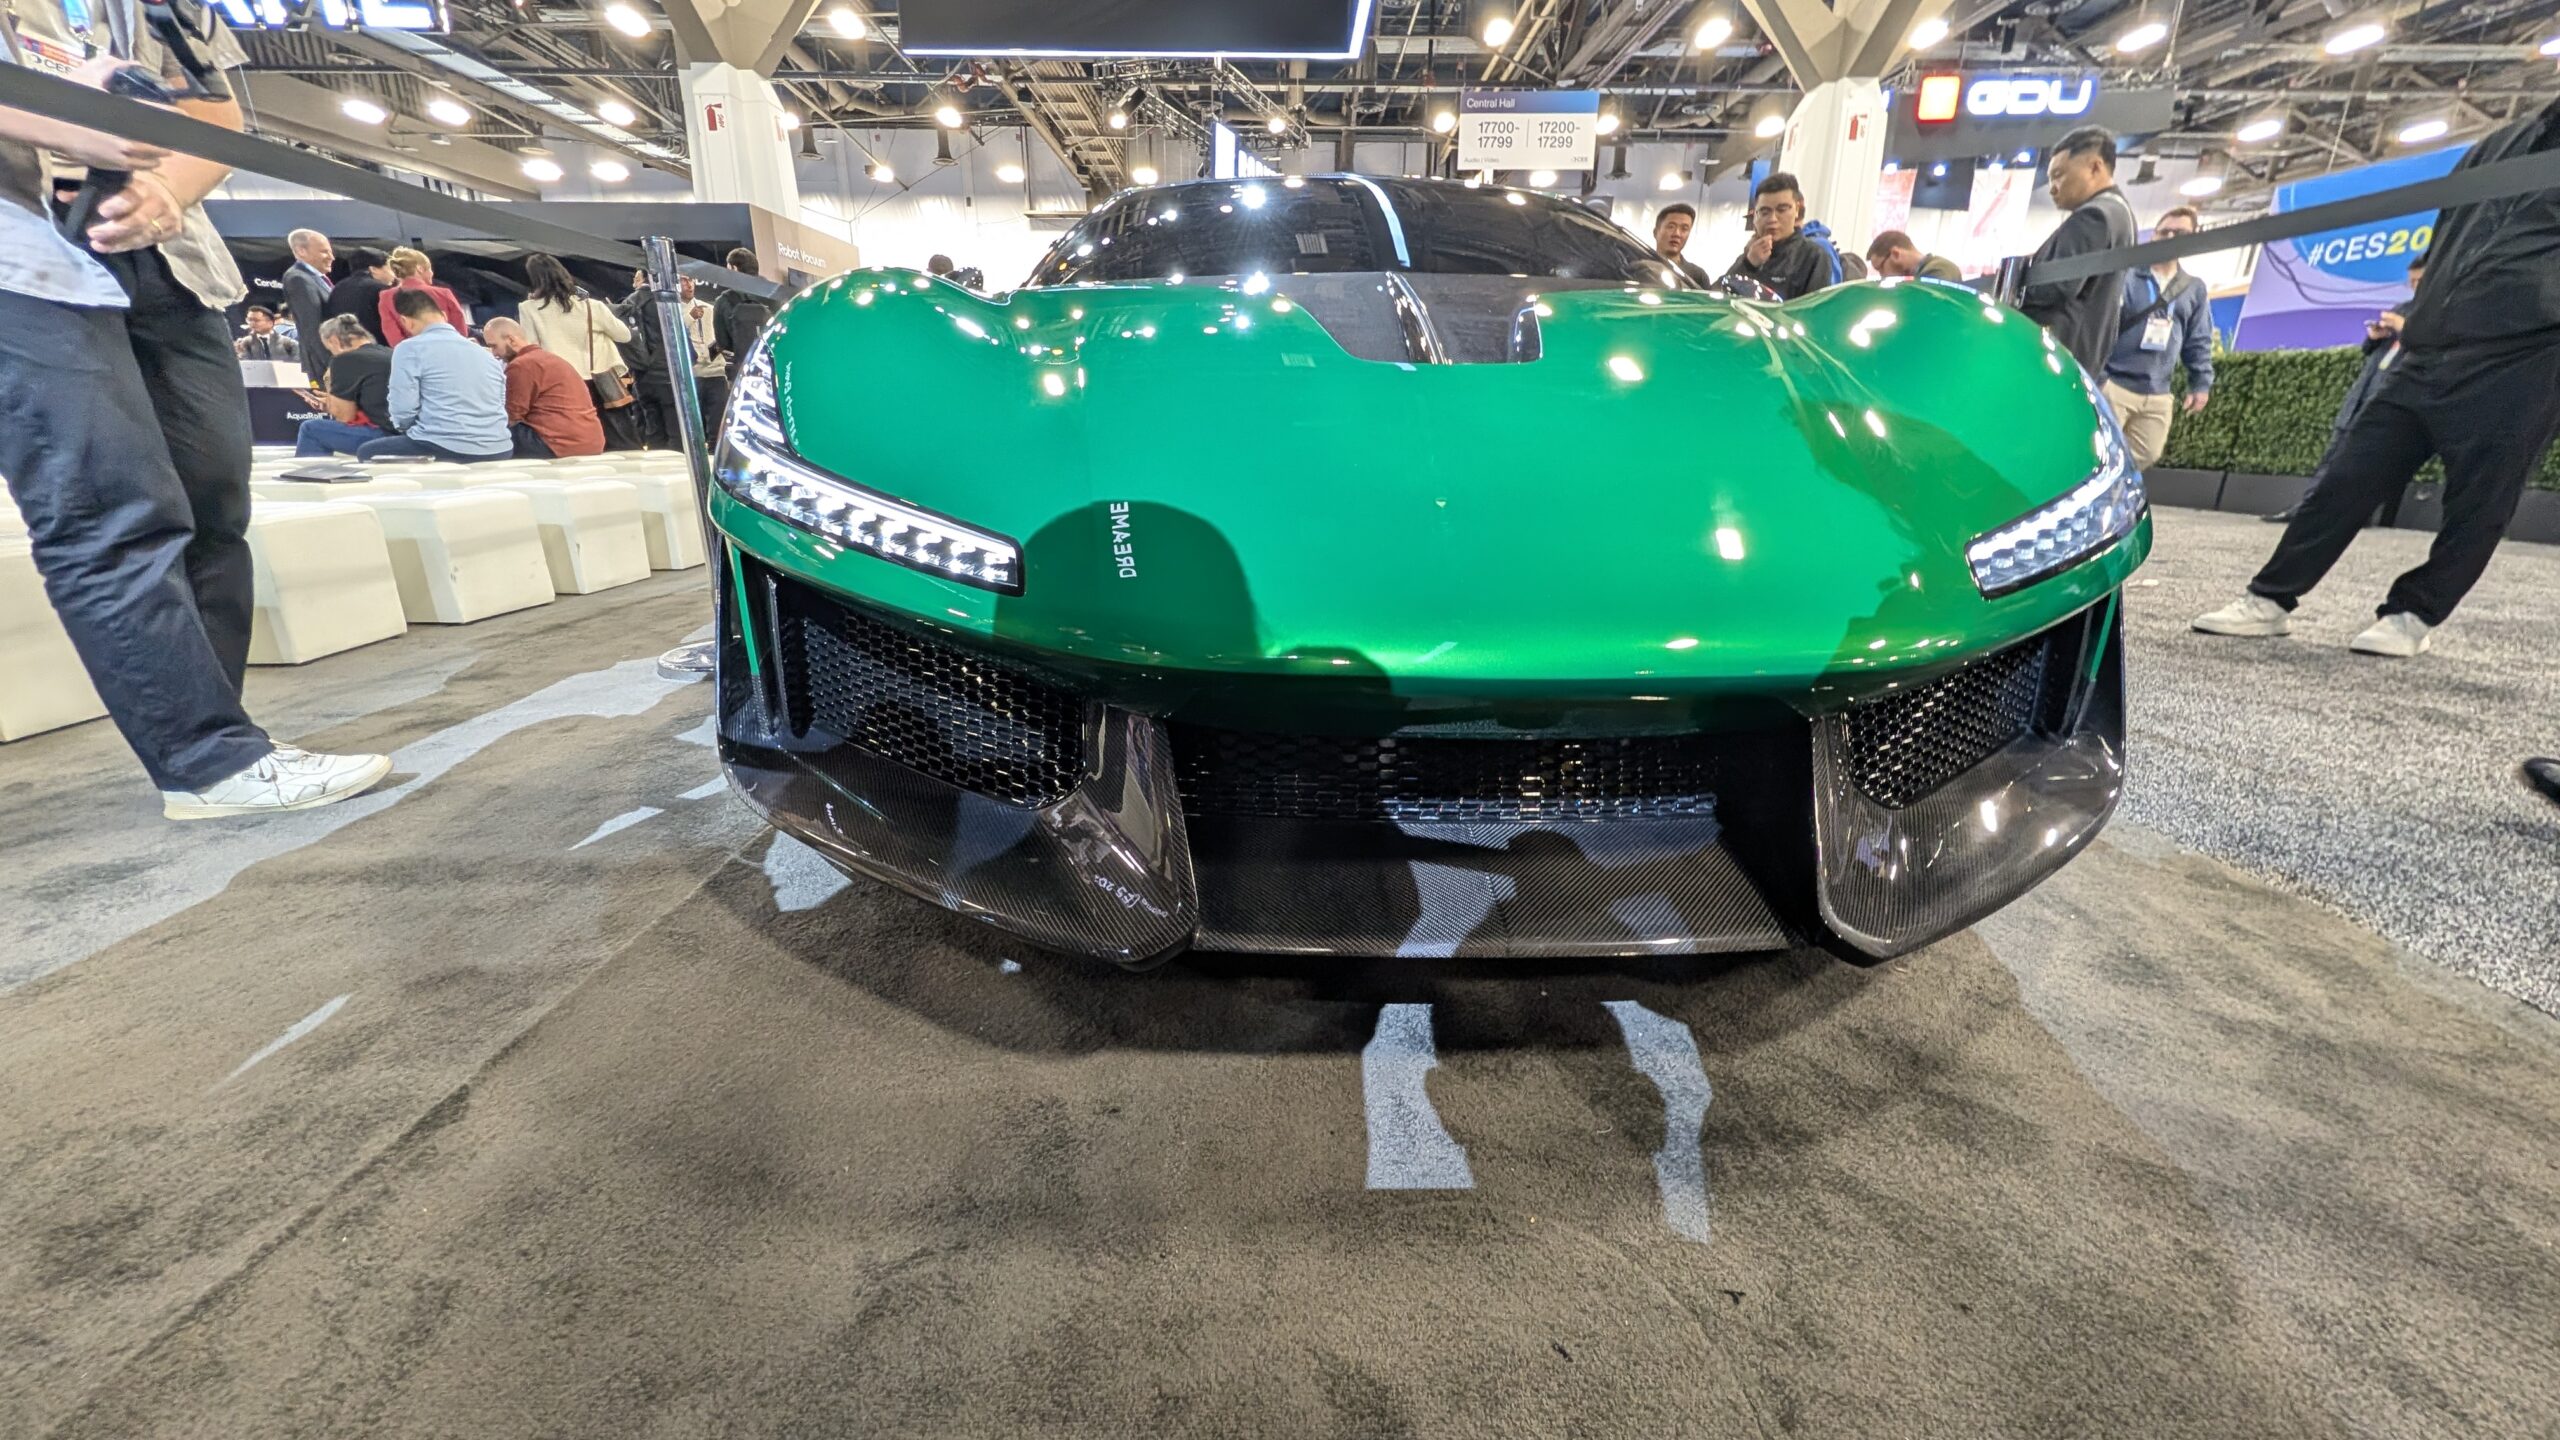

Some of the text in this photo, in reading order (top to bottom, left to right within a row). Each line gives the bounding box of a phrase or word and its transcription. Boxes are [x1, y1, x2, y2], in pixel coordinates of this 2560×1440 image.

[1466, 98, 1516, 108] Central Hall
[1478, 121, 1520, 134] 17700-
[1538, 121, 1581, 134] 17200-
[1478, 136, 1513, 148] 17799
[1537, 136, 1573, 148] 17299
[777, 241, 826, 269] Robot Vacuum
